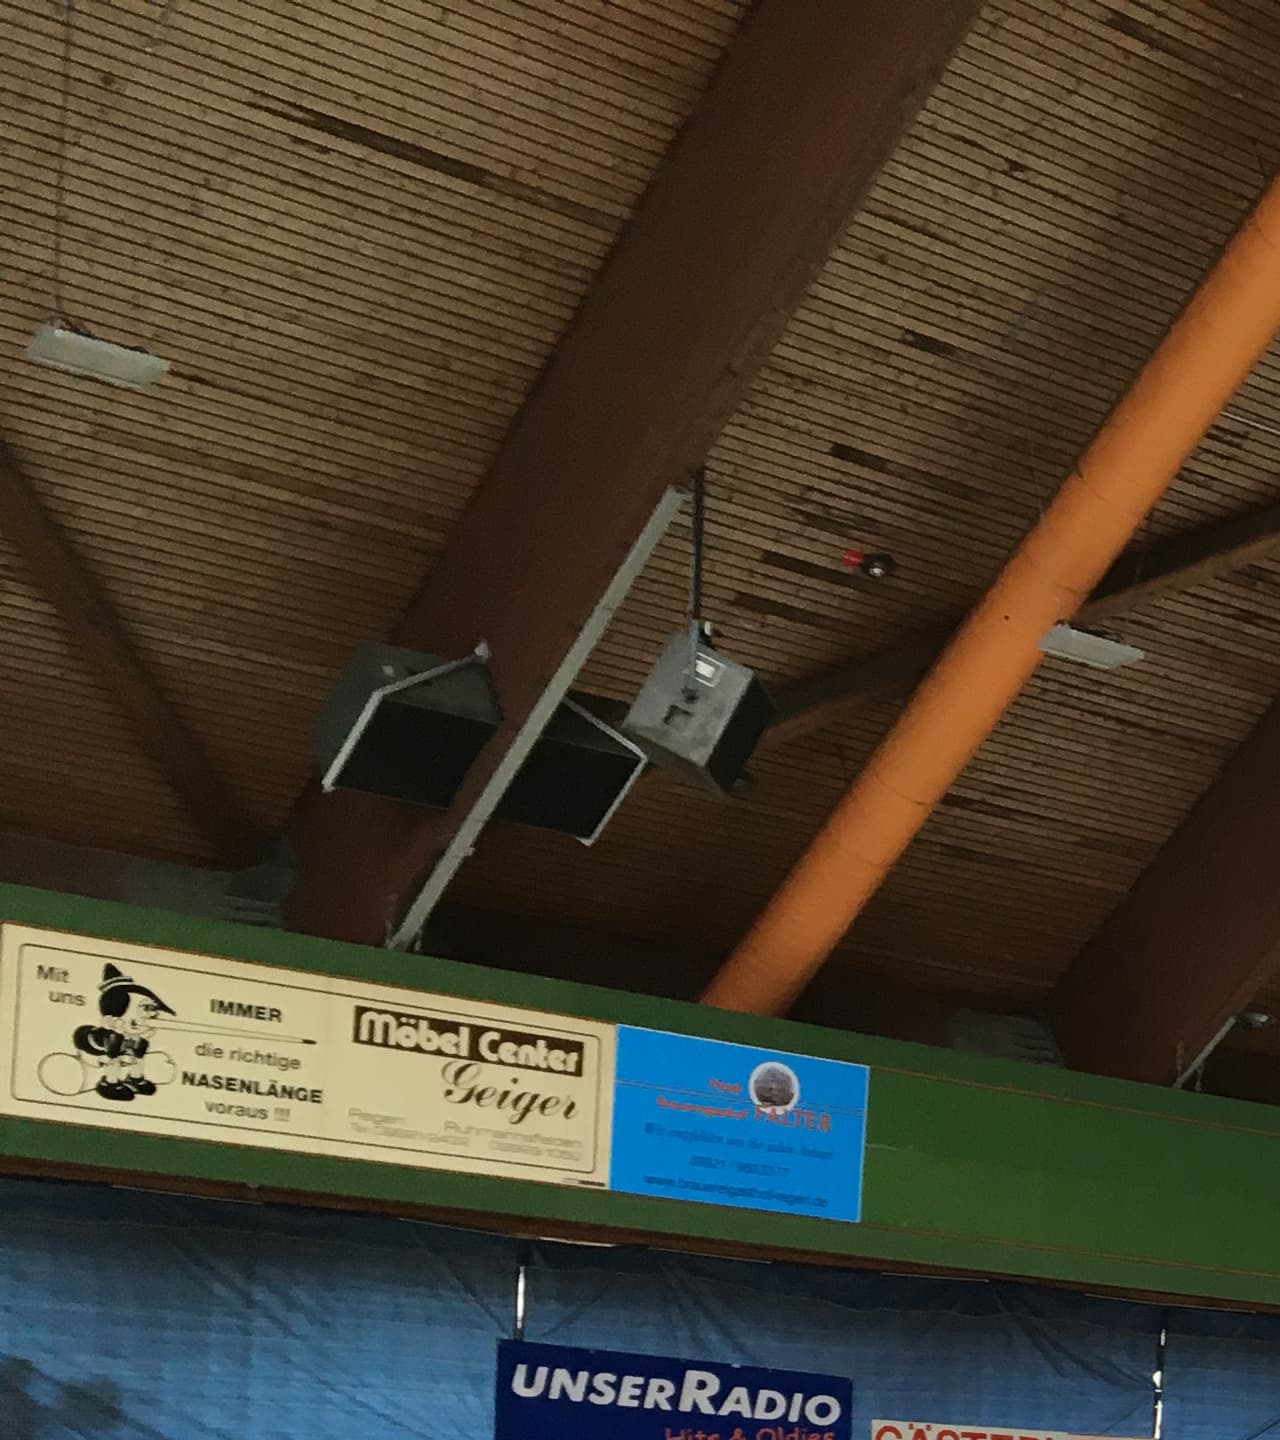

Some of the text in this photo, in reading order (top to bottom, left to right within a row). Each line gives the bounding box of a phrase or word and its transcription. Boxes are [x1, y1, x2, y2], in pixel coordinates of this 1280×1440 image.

[36, 964, 71, 984] Mit
[48, 990, 87, 1007] uns
[209, 998, 283, 1023] IMMER
[359, 1010, 579, 1073] Möbel Center
[194, 1042, 302, 1072] die richtige
[181, 1071, 324, 1104] NASENLÄNGE
[440, 1060, 578, 1125] Geiger
[204, 1101, 270, 1120] voraus
